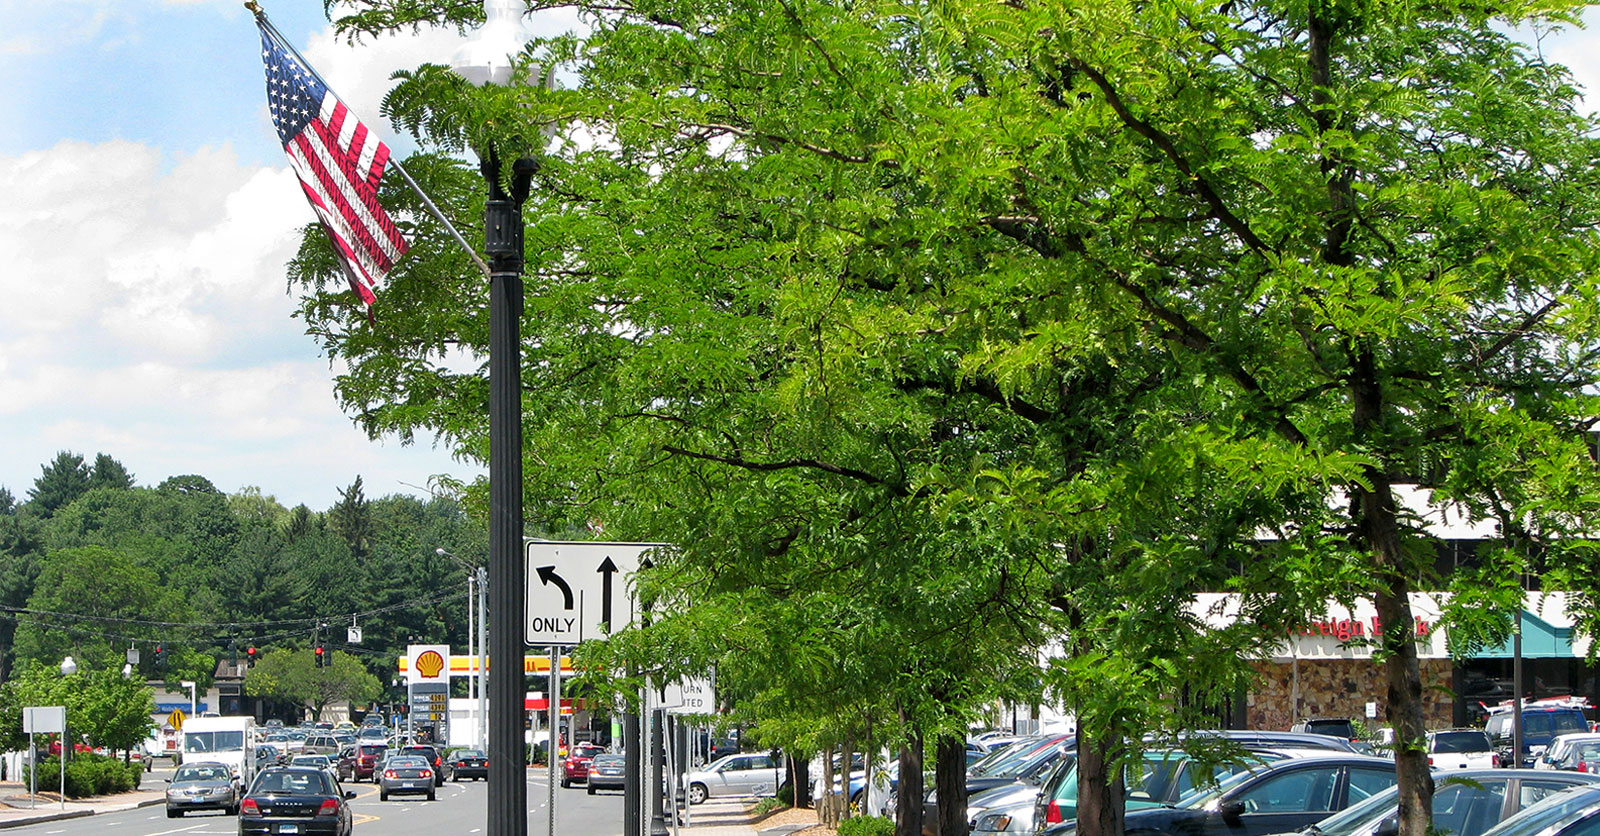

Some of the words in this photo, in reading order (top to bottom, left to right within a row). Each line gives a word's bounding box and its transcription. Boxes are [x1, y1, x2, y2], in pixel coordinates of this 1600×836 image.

[532, 617, 575, 632] ONLY
[1371, 615, 1429, 636] Bk
[683, 686, 703, 694] URN
